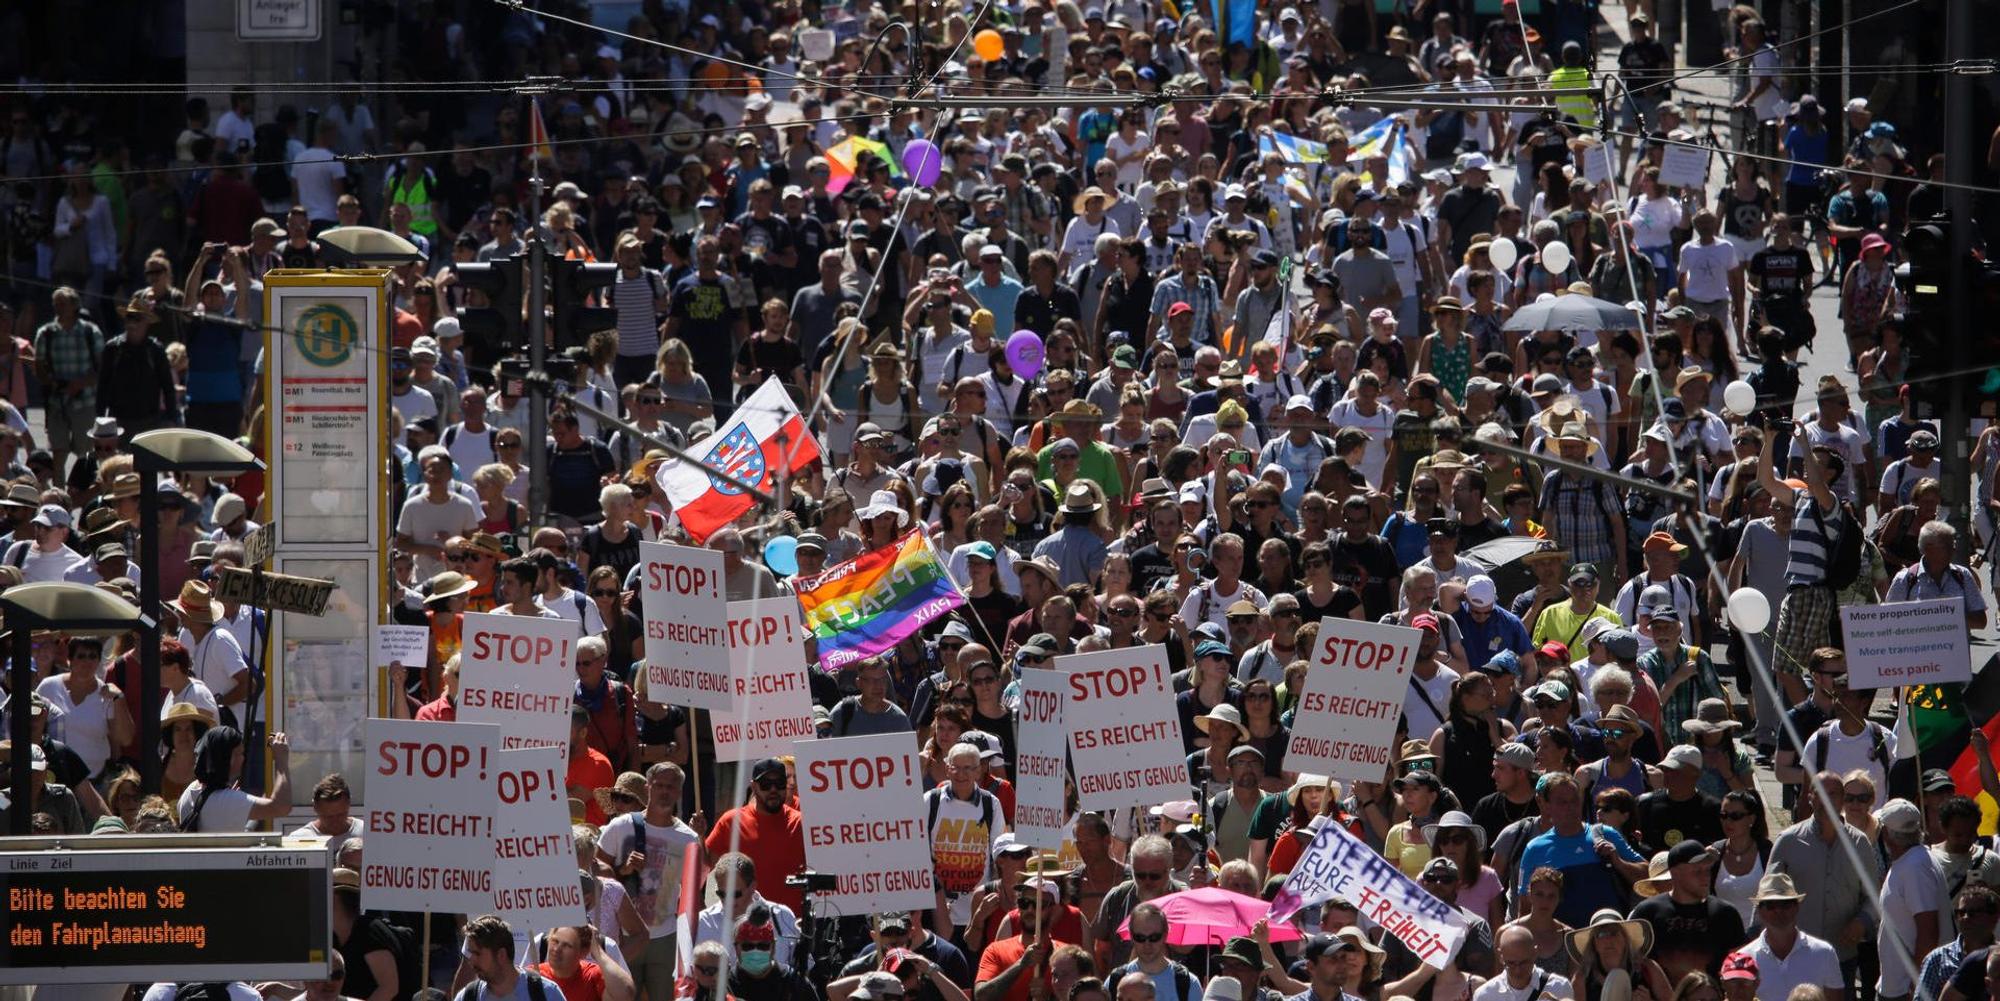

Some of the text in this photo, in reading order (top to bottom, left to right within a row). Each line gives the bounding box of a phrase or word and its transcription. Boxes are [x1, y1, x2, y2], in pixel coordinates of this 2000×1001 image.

[1850, 604, 1956, 620] More proportionality
[648, 620, 664, 640] ES
[1851, 623, 1958, 639] More self-determination
[1859, 642, 1954, 656] More transparency
[649, 665, 729, 694] GENUG IST GENUG
[1878, 662, 1941, 677] Less panic
[463, 688, 486, 707] ES
[1304, 692, 1325, 712] ES
[756, 720, 772, 739] IST
[774, 717, 813, 738] GENUG
[1074, 730, 1097, 749] ES
[1291, 736, 1388, 765] GENUG IST GENUG
[1019, 754, 1029, 775] ES
[1080, 764, 1186, 794] GENUG IST GENUG
[370, 811, 395, 833] ES
[1016, 804, 1062, 829] GENUG IST GENUG
[810, 825, 835, 846] ES
[10, 855, 306, 870] Linie Ziel Abfahrt in
[1312, 826, 1403, 892] STEHT
[365, 865, 490, 892] GENUG IST GENUG
[863, 871, 881, 893] IST
[885, 869, 931, 891] GENUG
[1288, 871, 1327, 897] AUF
[1303, 852, 1354, 894] EURE
[10, 885, 185, 911] Bitte beachten Sie
[515, 888, 532, 908] IST
[536, 886, 580, 908] GENUG
[10, 921, 206, 950] den Fahrplanaushang
